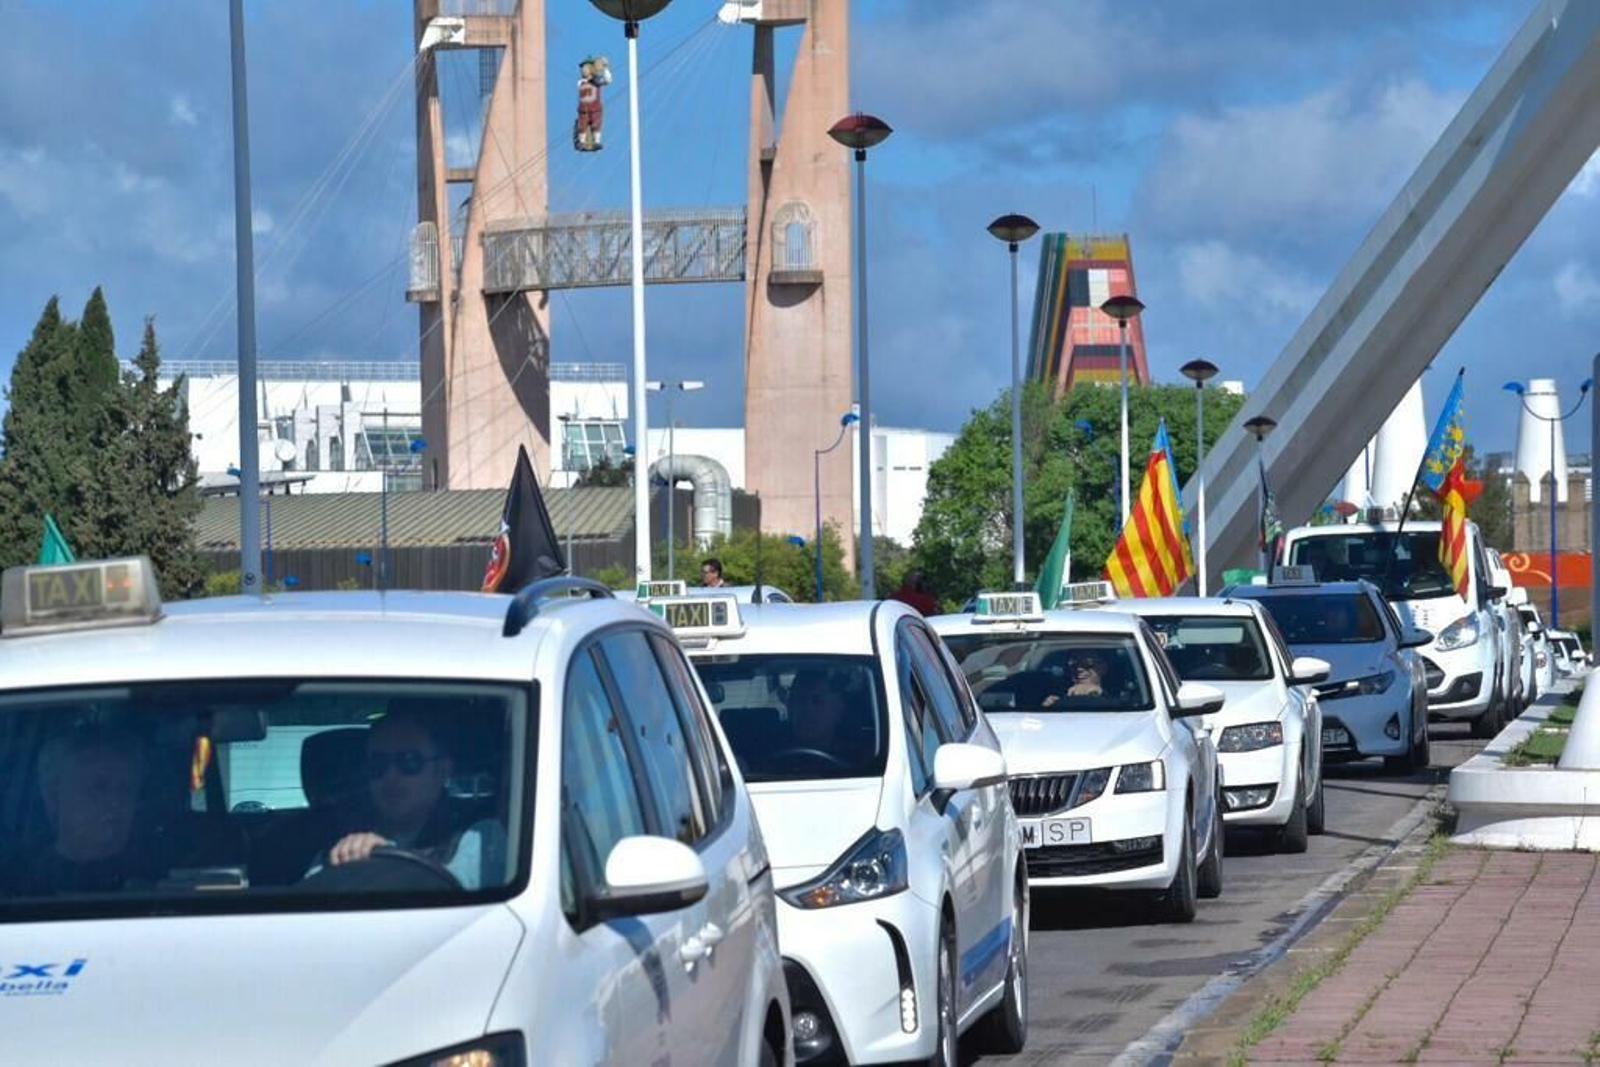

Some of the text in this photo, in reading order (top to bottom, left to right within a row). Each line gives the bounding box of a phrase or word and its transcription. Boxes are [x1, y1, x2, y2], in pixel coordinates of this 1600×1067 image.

[32, 570, 101, 606] TAXI
[667, 603, 708, 626] TAXI
[991, 597, 1019, 613] TAXI
[1049, 821, 1085, 842] SP
